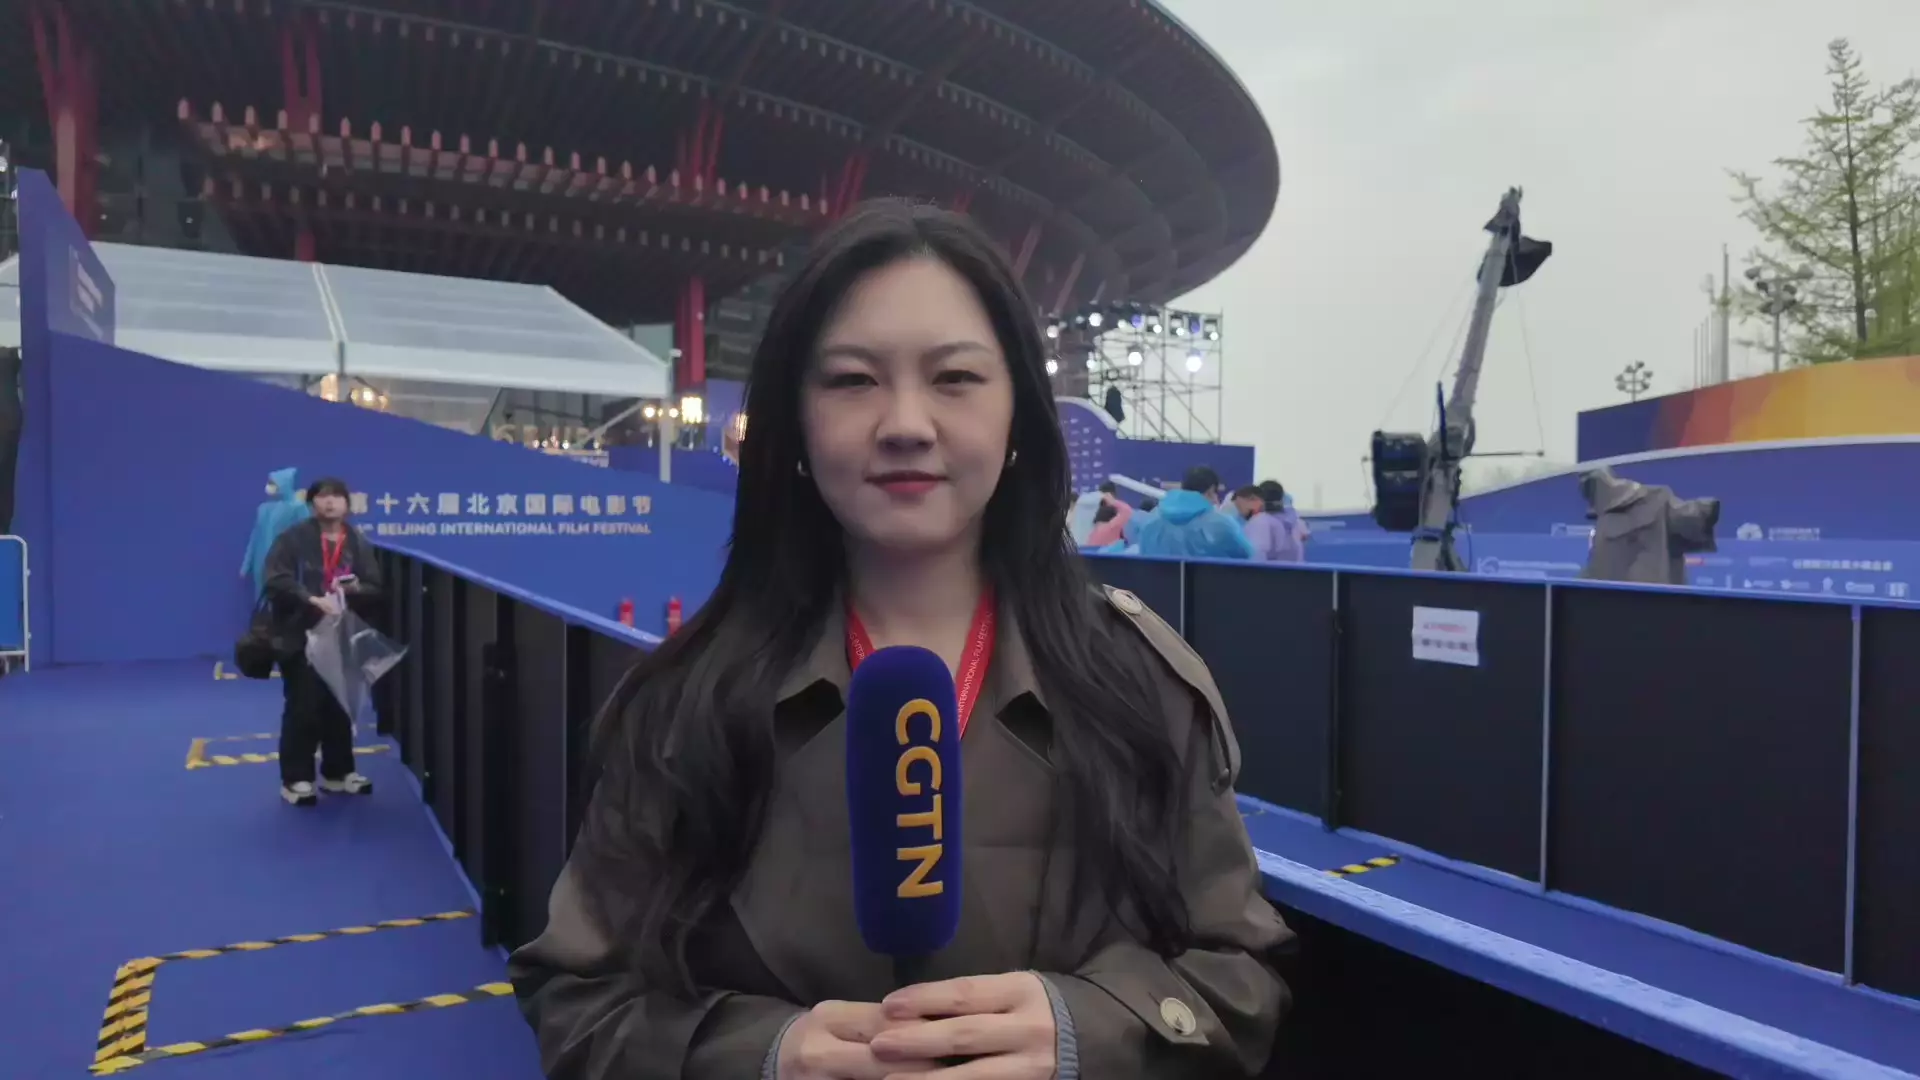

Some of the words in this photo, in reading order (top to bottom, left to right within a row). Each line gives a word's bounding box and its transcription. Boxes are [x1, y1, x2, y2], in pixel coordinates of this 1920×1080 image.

[377, 523, 437, 535] BEIJING
[440, 523, 555, 535] INTERNATIONAL
[558, 523, 590, 535] FILM
[593, 523, 652, 535] FESTIVAL
[895, 698, 944, 898] CGTN
